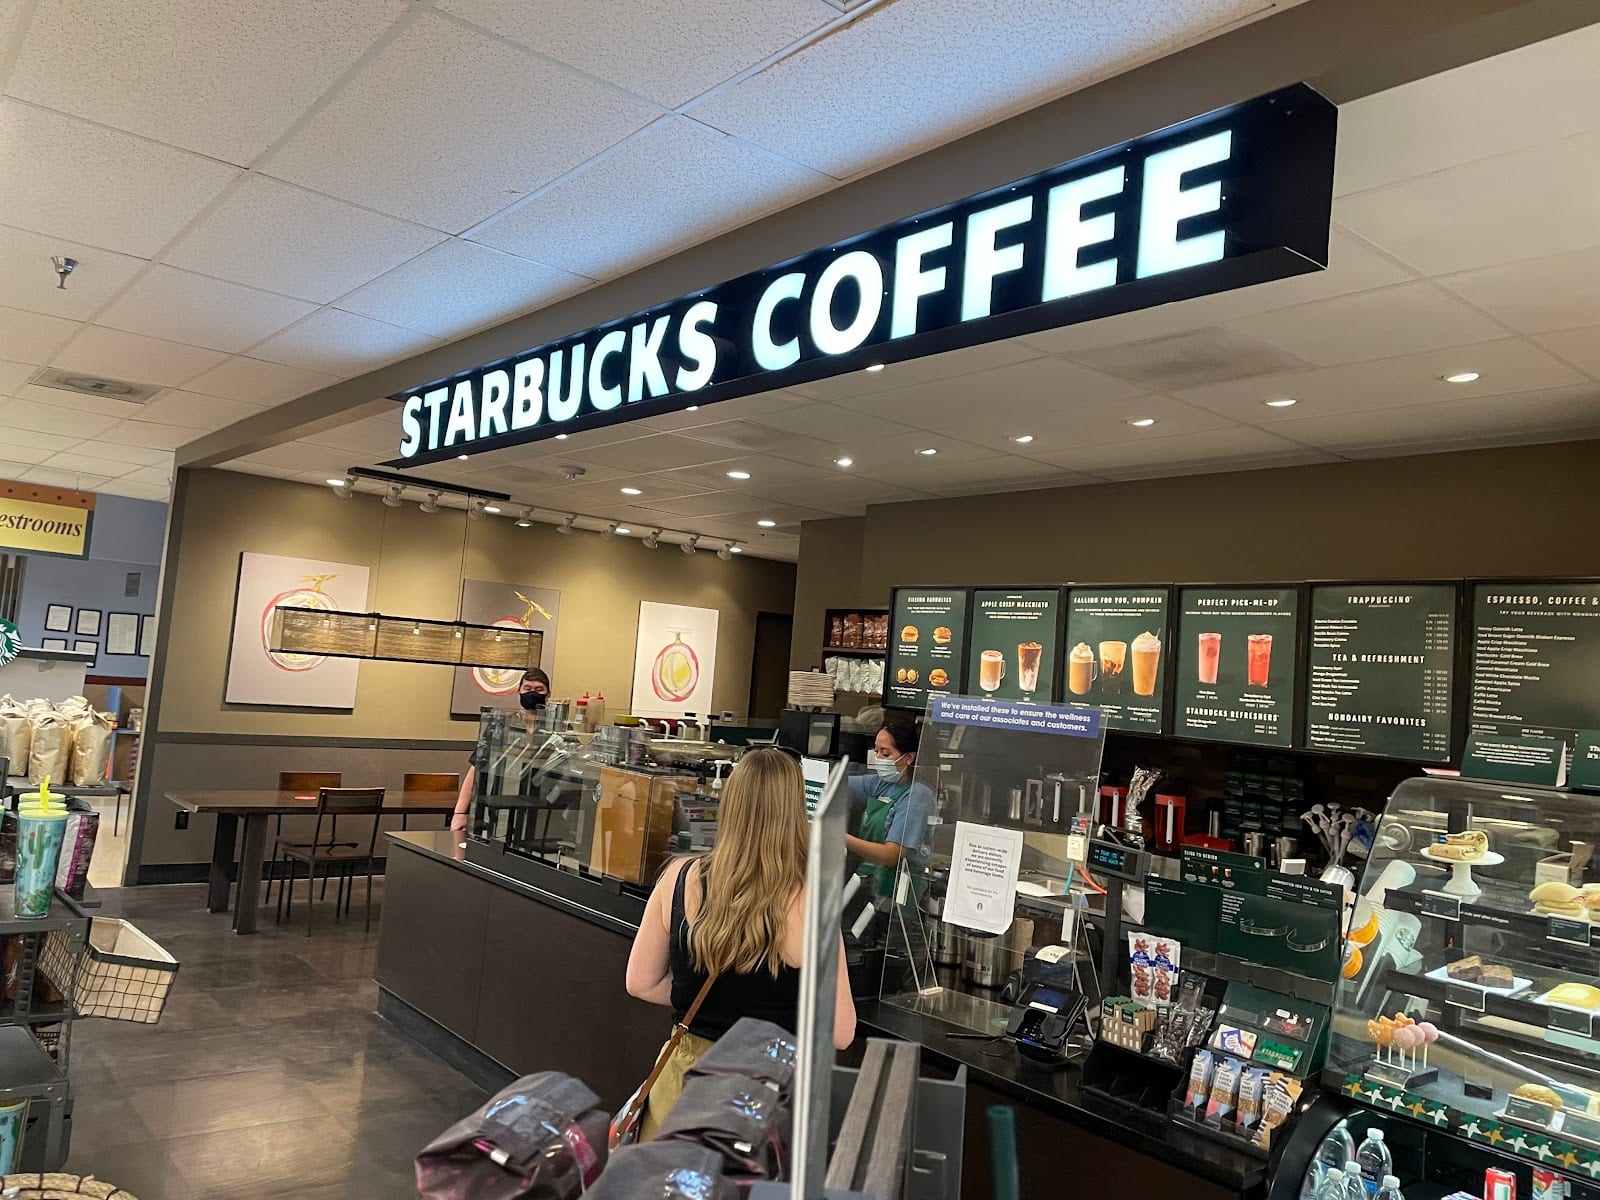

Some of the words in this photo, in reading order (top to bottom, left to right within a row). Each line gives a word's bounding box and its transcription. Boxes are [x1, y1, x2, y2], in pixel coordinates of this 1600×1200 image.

[400, 299, 718, 459] STARBUCKS
[750, 129, 1232, 372] COFFEE
[0, 513, 83, 538] estrooms
[1487, 595, 1542, 605] ESPRESSO,
[1548, 596, 1587, 605] COFFEE
[1592, 597, 1599, 605] &
[1361, 654, 1425, 664] REFRESHMENT
[941, 702, 960, 710] We've
[961, 703, 990, 713] installed
[991, 706, 1010, 715] these
[1011, 708, 1019, 716] to
[1019, 709, 1044, 718] ensure
[1045, 710, 1058, 719] the
[1058, 712, 1091, 723] wellness
[1186, 707, 1228, 717] STARBUCKS
[1328, 713, 1372, 723] NONDAIRY
[1376, 716, 1426, 727] FAVORITES
[940, 710, 953, 718] and
[971, 713, 979, 721] of
[992, 716, 1029, 726] associates
[1030, 719, 1046, 728] and
[1046, 720, 1088, 732] customers.
